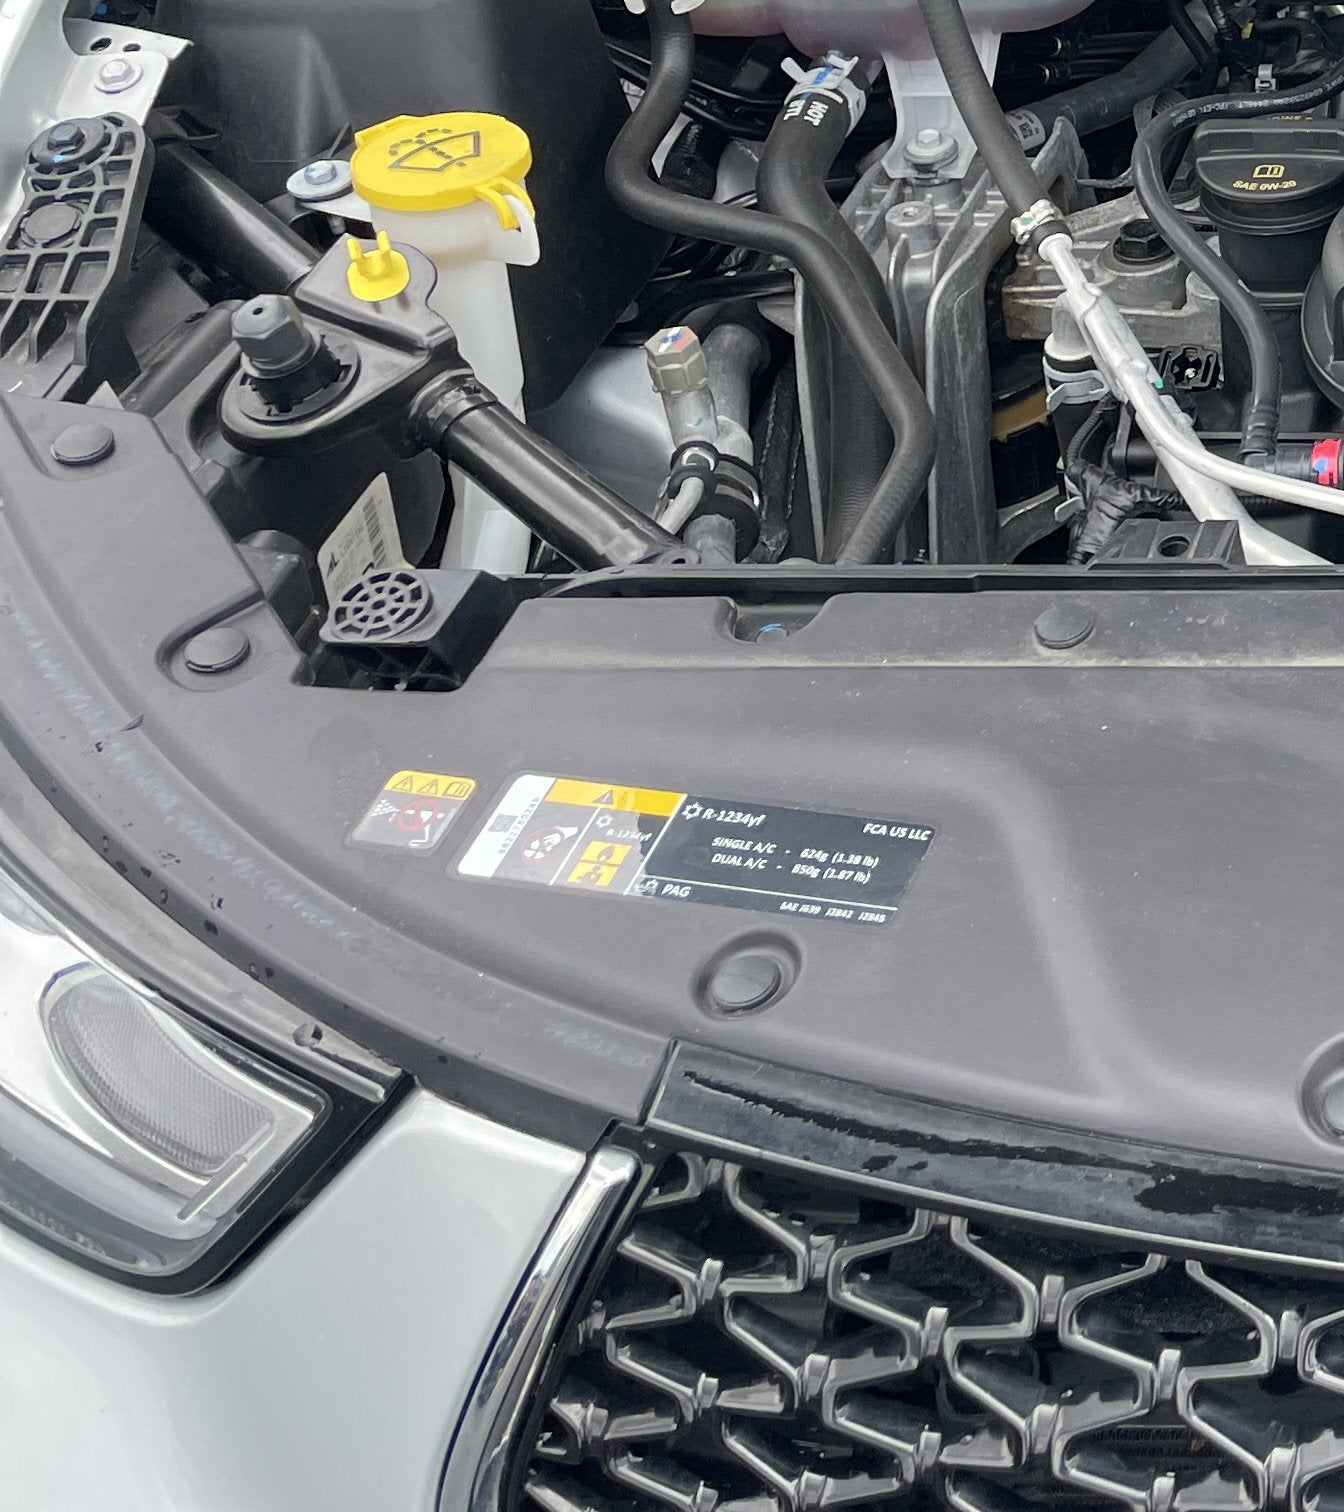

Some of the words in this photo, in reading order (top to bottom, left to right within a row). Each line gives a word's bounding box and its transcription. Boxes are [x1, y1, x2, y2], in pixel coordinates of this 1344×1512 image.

[804, 100, 829, 126] HOT
[1232, 180, 1257, 191] SAE
[1259, 179, 1297, 191] 0W-20
[702, 807, 767, 828] R-1234yf
[863, 822, 887, 836] FCA
[889, 826, 907, 838] US
[907, 828, 932, 842] LLC
[711, 836, 753, 851] SINGLE
[753, 841, 777, 855] A/C
[800, 848, 829, 863] 624g
[861, 855, 880, 869] lb)
[711, 853, 743, 867] DUAL
[744, 857, 768, 870] A/C
[791, 863, 821, 879] 850g
[853, 870, 872, 885] lb)
[661, 883, 692, 898] PAG
[780, 900, 798, 912] SAE
